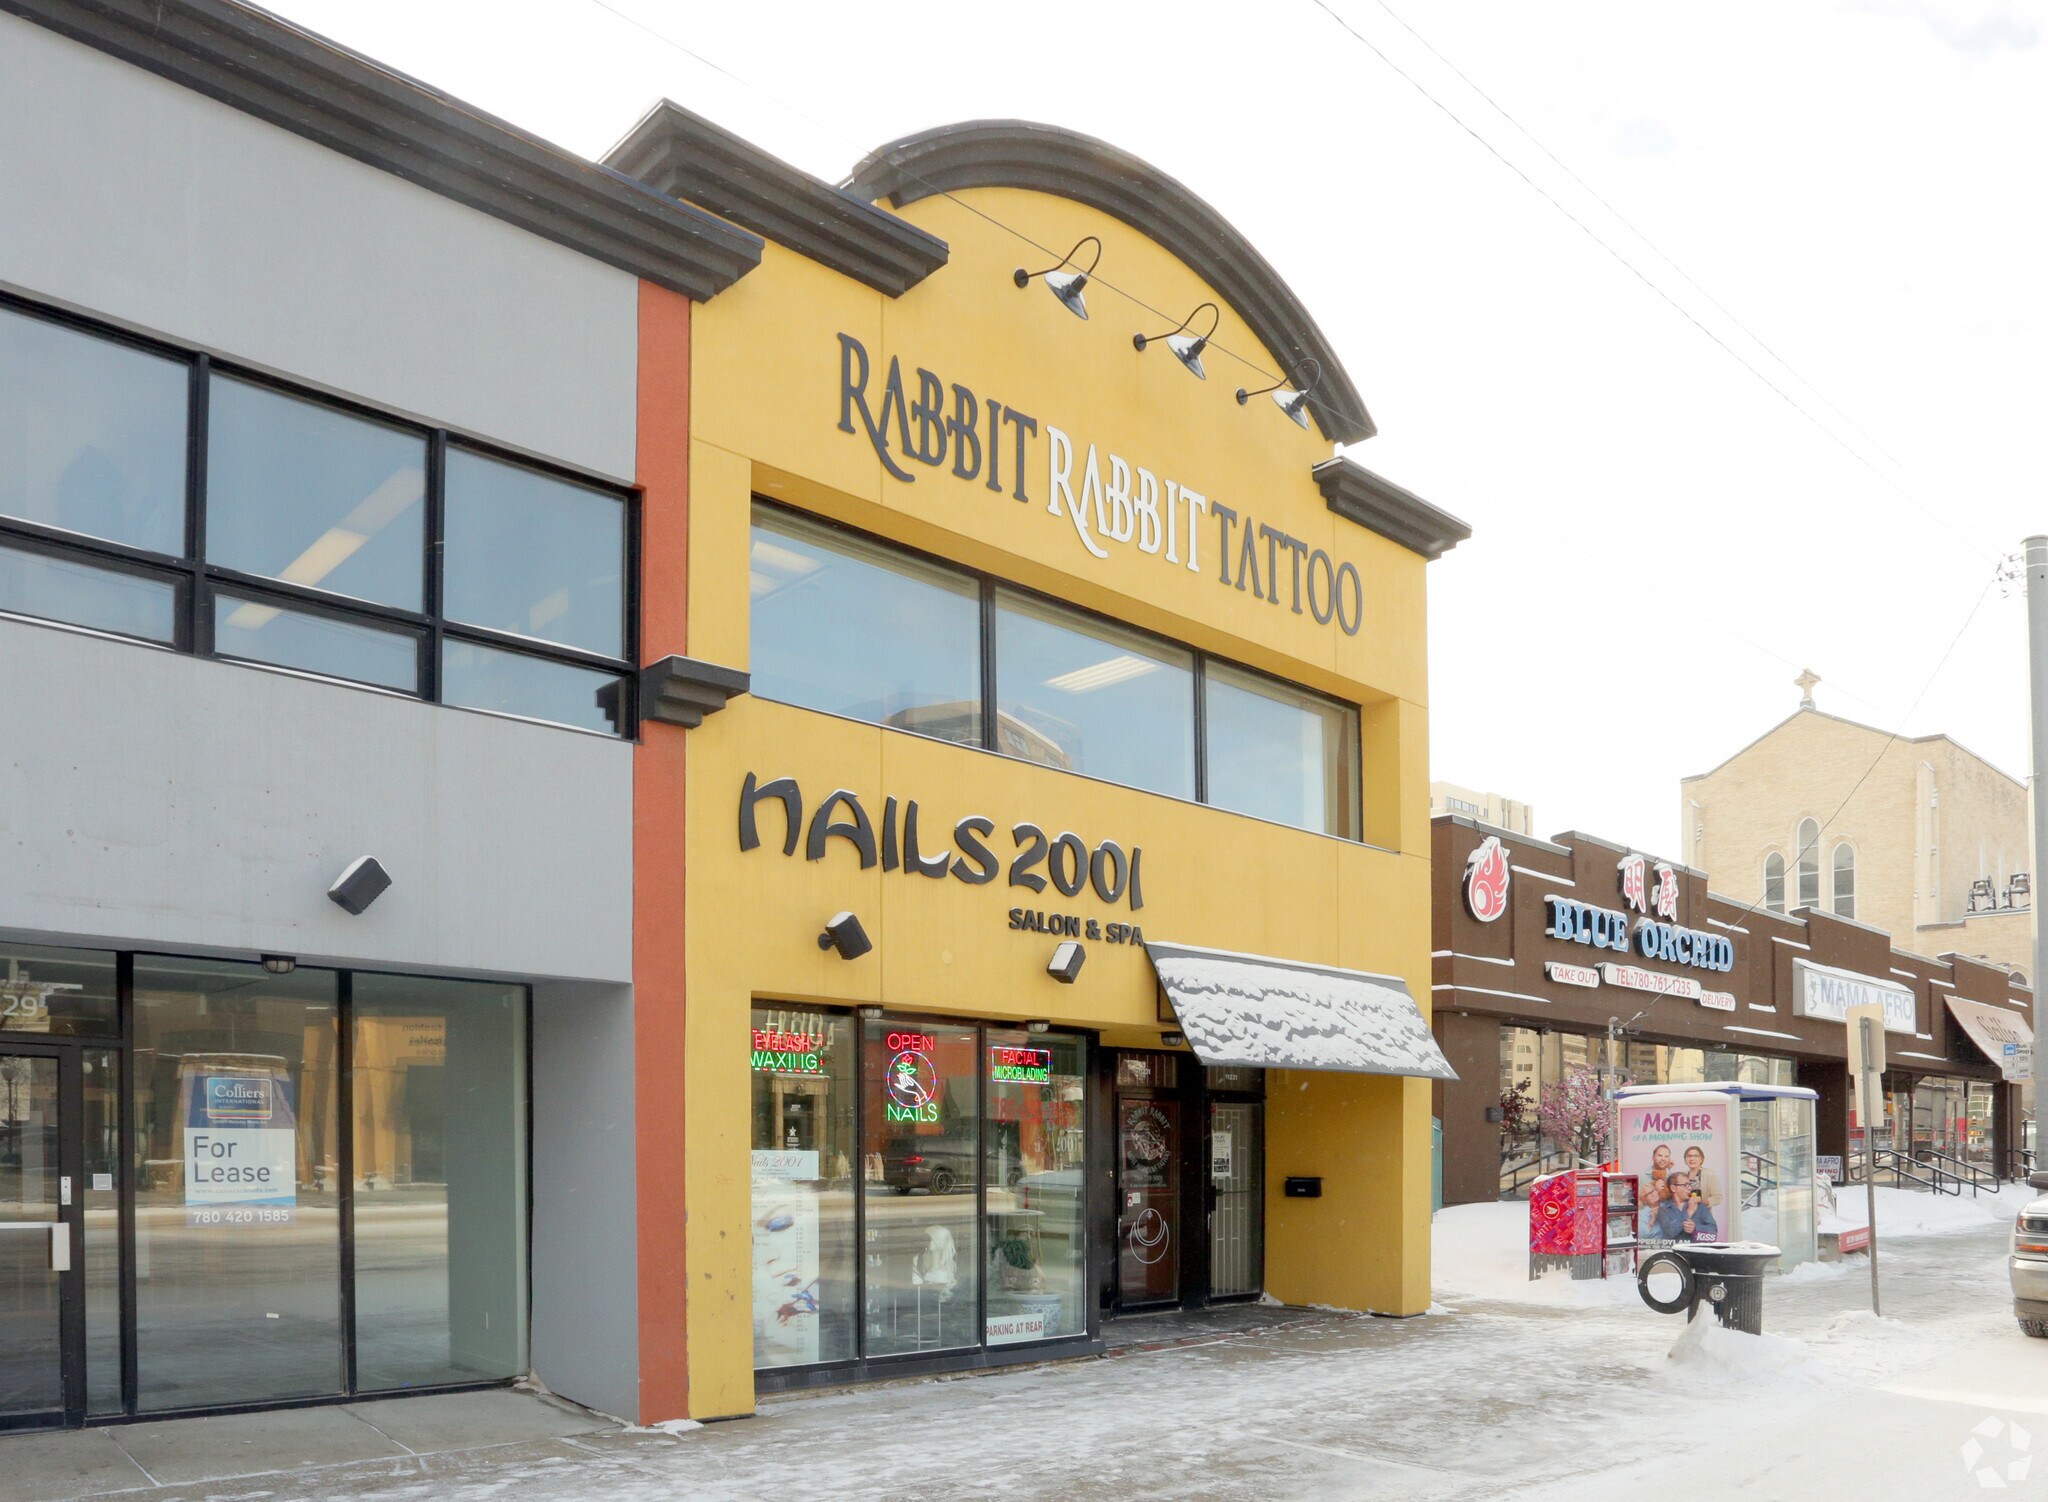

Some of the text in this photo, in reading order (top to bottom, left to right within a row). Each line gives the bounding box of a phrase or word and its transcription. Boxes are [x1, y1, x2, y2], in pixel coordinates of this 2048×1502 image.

[837, 332, 1363, 637] RABBIT RABBIT TATTOO
[1009, 822, 1145, 911] 2001
[1009, 906, 1145, 948] SALON & SPA
[1553, 900, 1735, 973] BLUE ORCHID
[1554, 966, 1598, 985] TAKE OUT
[1702, 993, 1733, 1008] DELIVERY
[1820, 977, 1913, 1020] MAMA AFRO
[755, 1033, 811, 1053] EYELASH
[887, 1033, 935, 1051] OPEN
[1002, 1050, 1040, 1067] FACIAL
[994, 1065, 1048, 1081] MICROBLADING
[214, 1084, 265, 1099] Colliers
[887, 1103, 938, 1121] NAILS
[1633, 1113, 1713, 1132] A MOTHER
[1649, 1132, 1687, 1141] MORNING
[1689, 1133, 1713, 1141] SHOW
[194, 1136, 238, 1158] For
[1823, 1157, 1839, 1165] AFRO
[195, 1161, 271, 1183] Lease
[194, 1210, 289, 1224] 780 420 1585
[986, 1320, 1043, 1336] PARKING AT REAR
